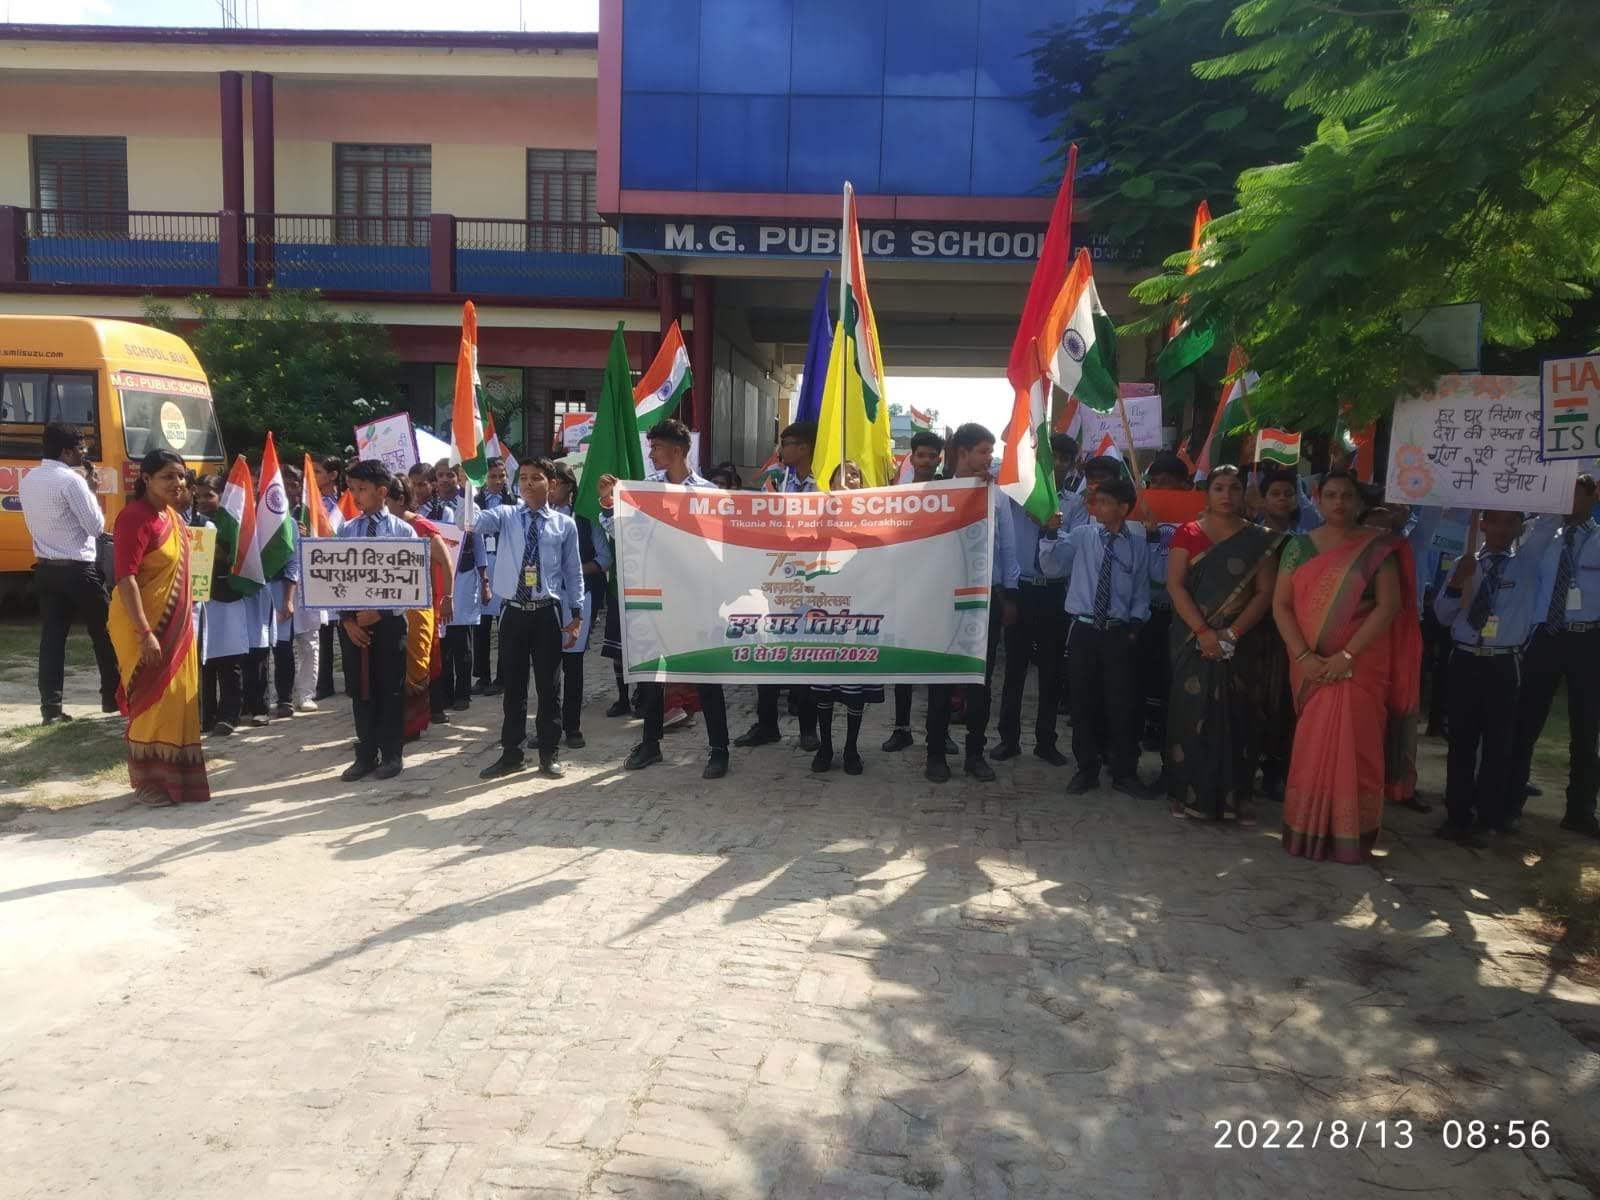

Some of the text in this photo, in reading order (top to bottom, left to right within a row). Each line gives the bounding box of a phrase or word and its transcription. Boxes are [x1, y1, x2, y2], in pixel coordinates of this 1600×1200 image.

[664, 223, 745, 251] M.G.
[124, 344, 190, 364] SCHOOL BUS
[110, 374, 211, 399] M.G. PUBLIC SCHOOL
[1547, 425, 1584, 452] IS
[689, 494, 955, 516] M.G. PUBLIC SCHOOL
[730, 520, 766, 528] Tikonia
[798, 519, 823, 528] Padri
[827, 519, 857, 528] Bazar,
[861, 518, 913, 528] Gorakhpur
[726, 609, 884, 639] हर घर तिरंगा
[733, 647, 750, 662] 13
[791, 647, 837, 662] अगस्त
[839, 647, 879, 662] 2022
